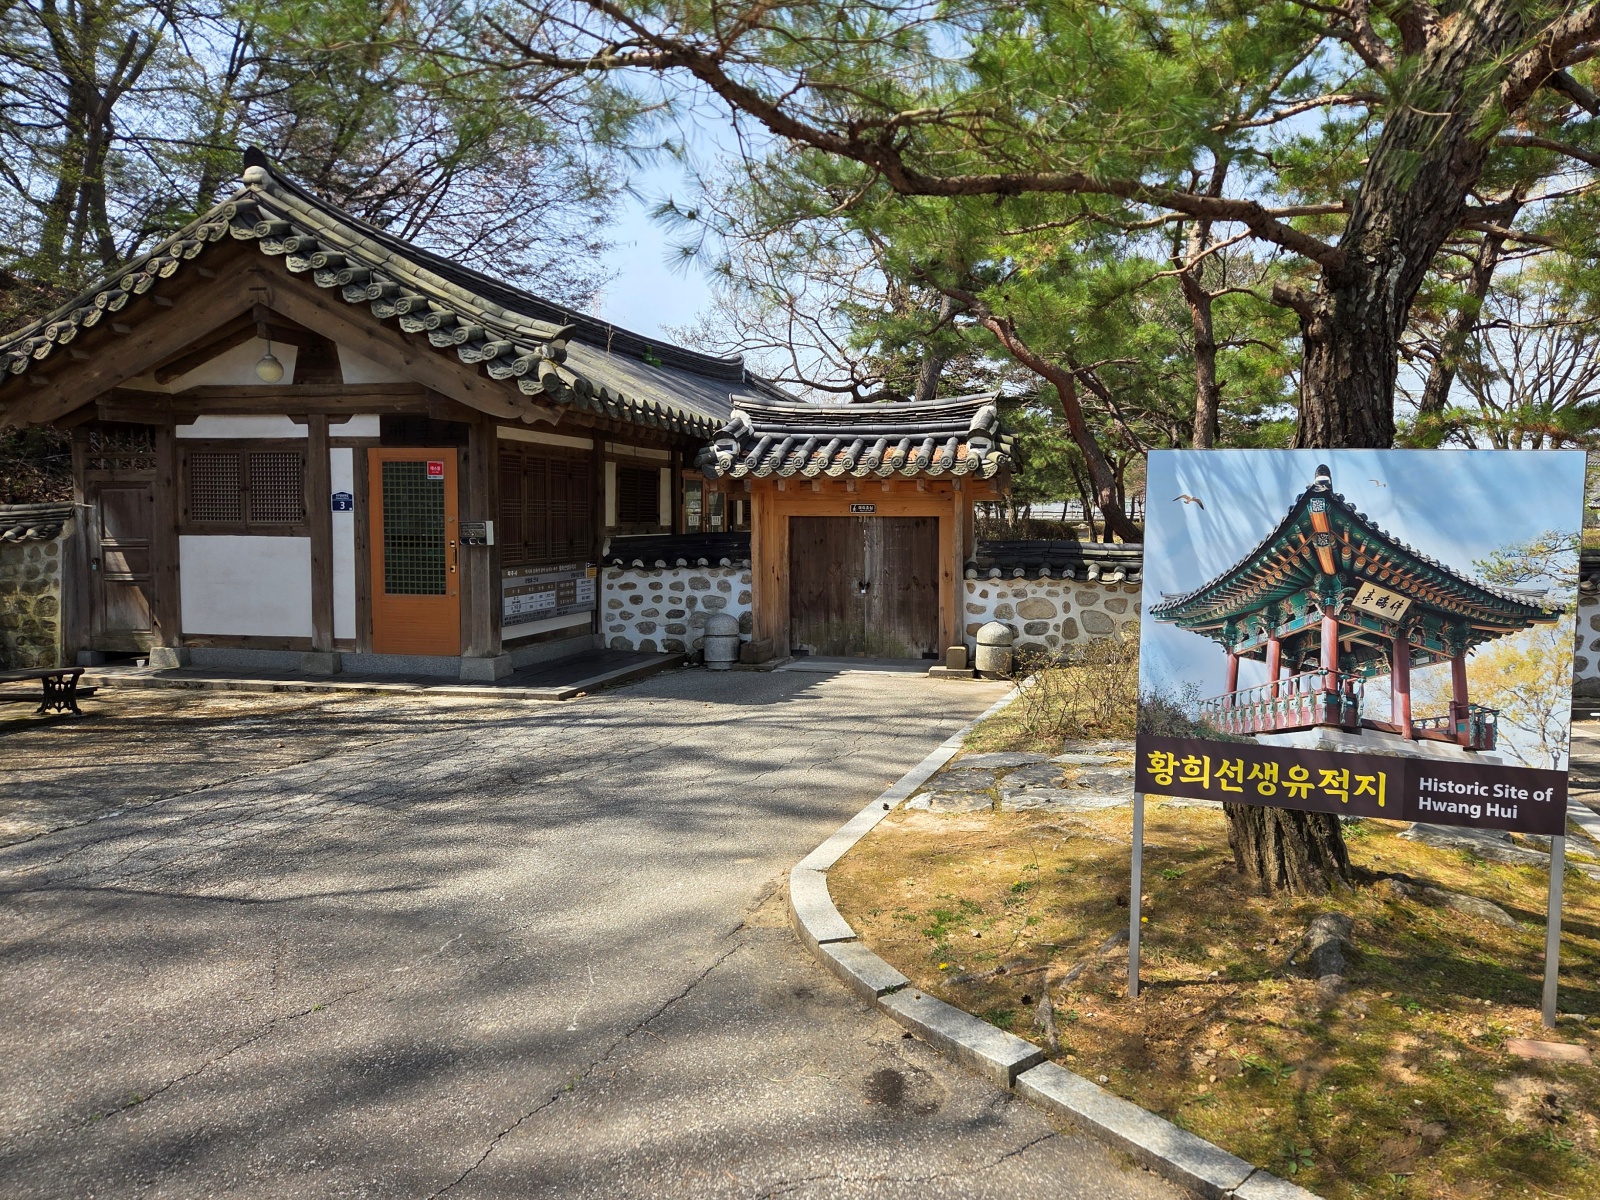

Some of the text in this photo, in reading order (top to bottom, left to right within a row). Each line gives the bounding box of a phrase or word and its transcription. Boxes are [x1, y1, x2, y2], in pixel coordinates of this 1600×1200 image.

[340, 501, 346, 510] 3
[1146, 750, 1387, 808] 황희선생유적지
[1419, 777, 1554, 802] Historic Site of
[1418, 796, 1518, 819] Hwang Hui
